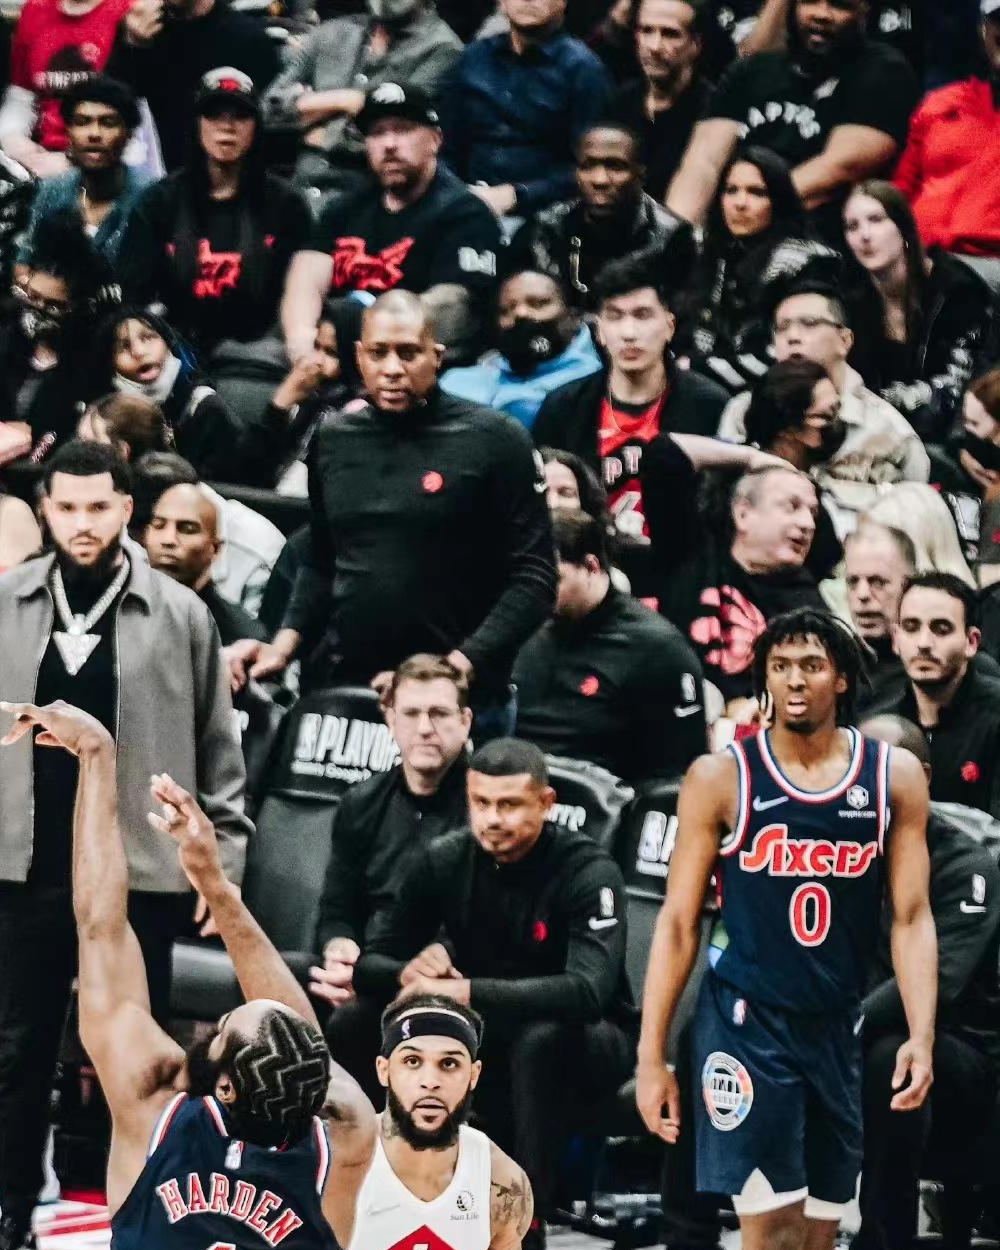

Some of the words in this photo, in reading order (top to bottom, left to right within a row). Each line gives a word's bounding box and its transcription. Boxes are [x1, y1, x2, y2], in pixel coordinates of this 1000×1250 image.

[739, 823, 878, 878] Sixers
[789, 881, 832, 948] 0
[155, 1172, 304, 1248] HARDEN
